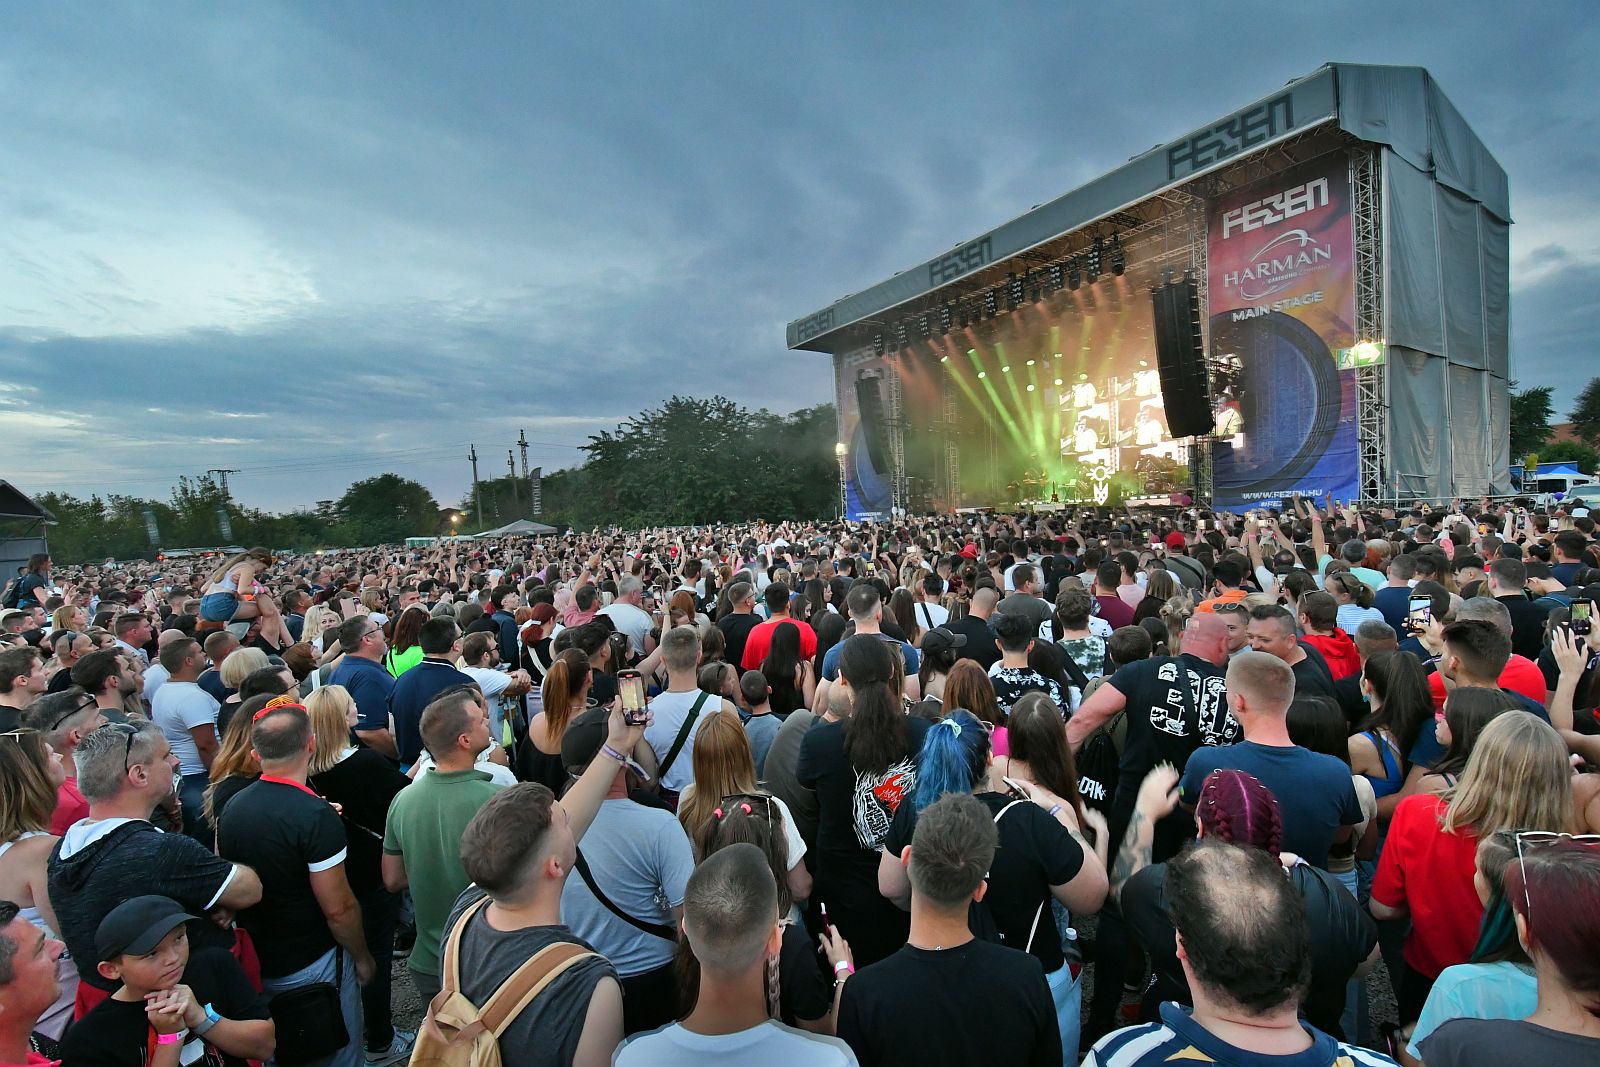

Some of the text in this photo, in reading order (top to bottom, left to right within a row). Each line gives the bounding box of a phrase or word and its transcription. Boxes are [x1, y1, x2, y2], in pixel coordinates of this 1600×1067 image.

[1168, 92, 1294, 181] FEZEN
[1223, 176, 1329, 240] FEZEN
[928, 235, 992, 289] FEZEN
[1223, 243, 1331, 288] HARMAN
[1232, 290, 1324, 323] MAIN STAGE
